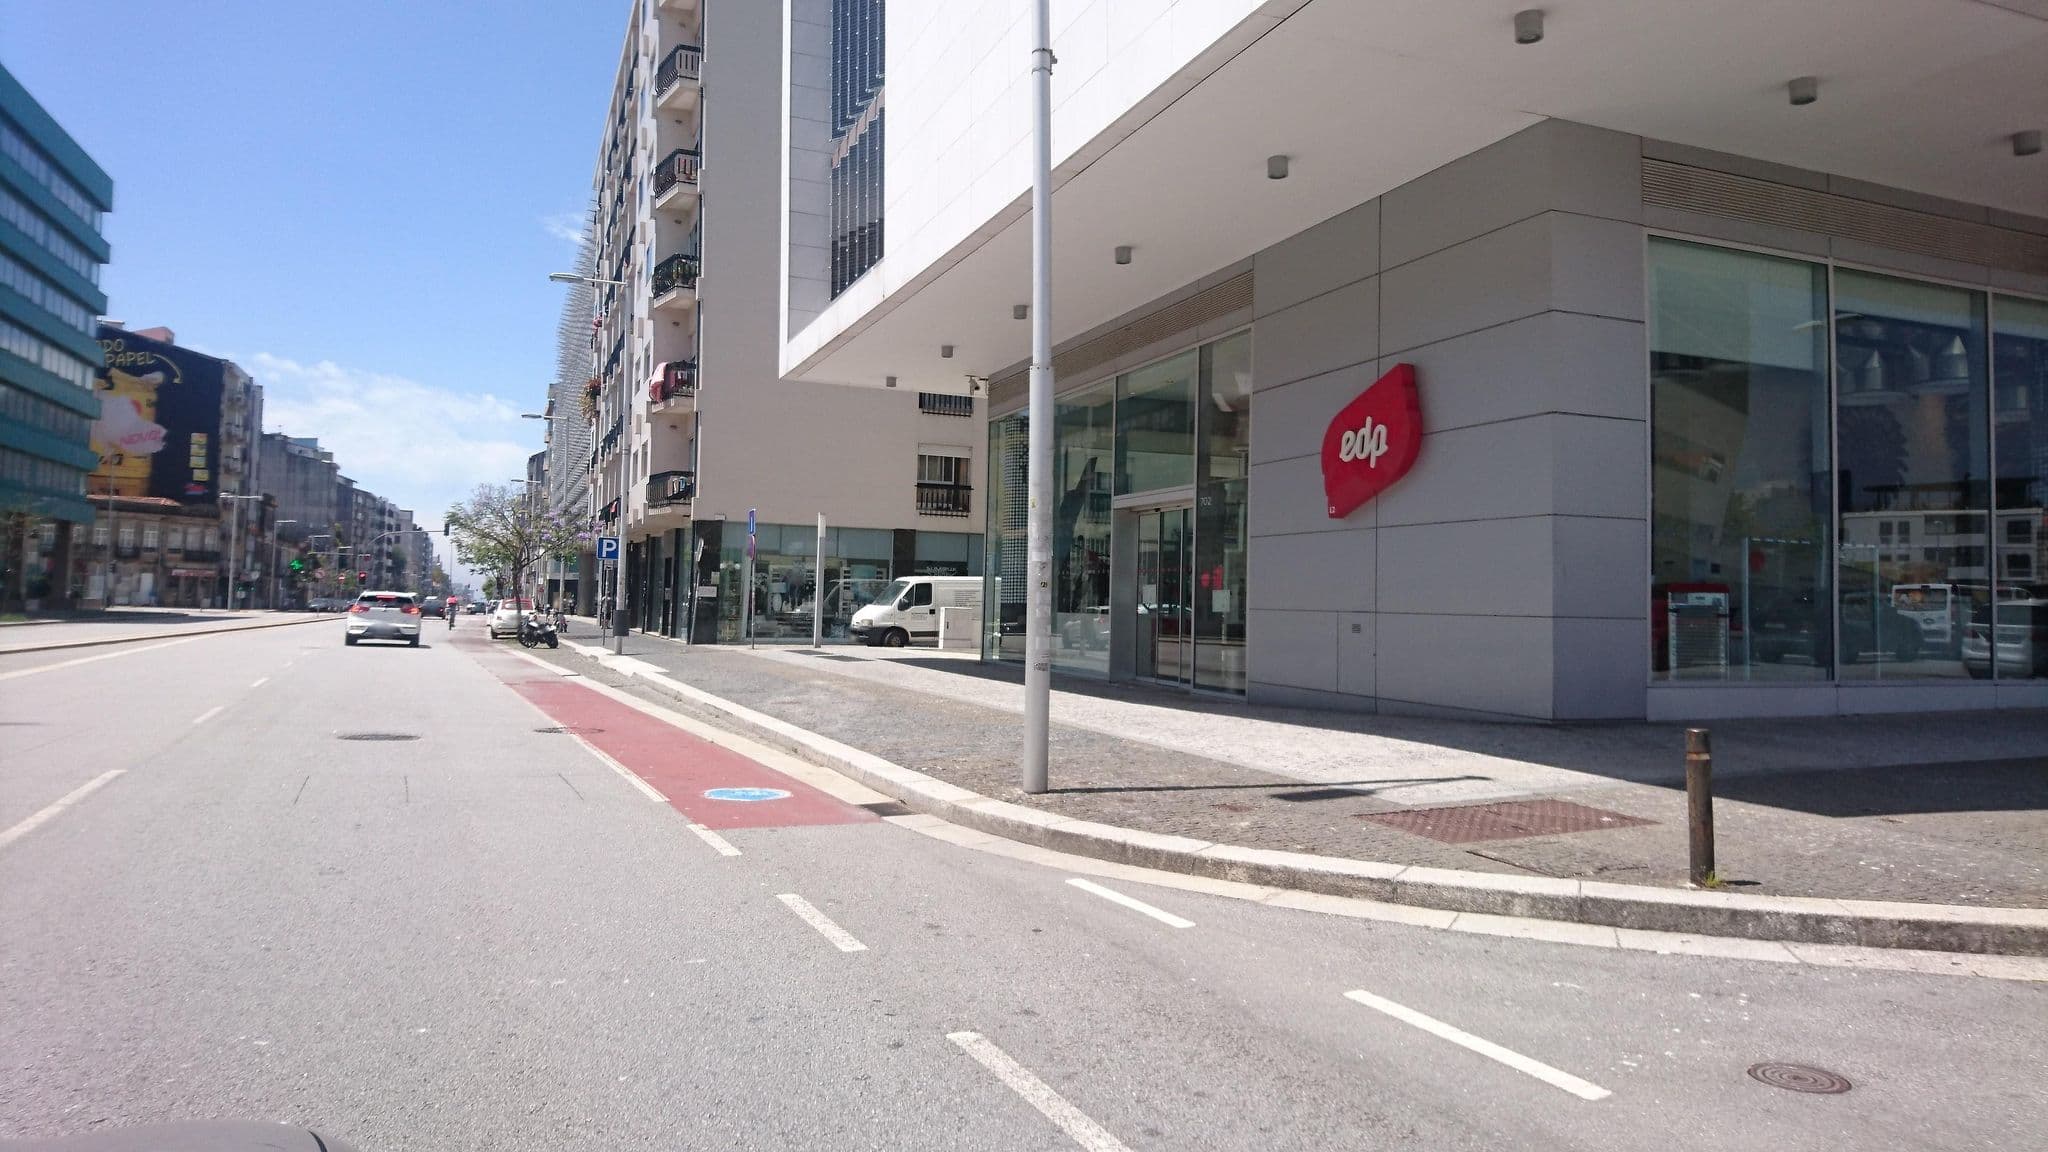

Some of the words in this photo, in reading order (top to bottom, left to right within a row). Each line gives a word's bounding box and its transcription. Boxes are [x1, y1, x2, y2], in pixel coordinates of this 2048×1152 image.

[105, 351, 157, 368] PAPEL
[1339, 415, 1389, 469] edp
[602, 539, 617, 557] P
